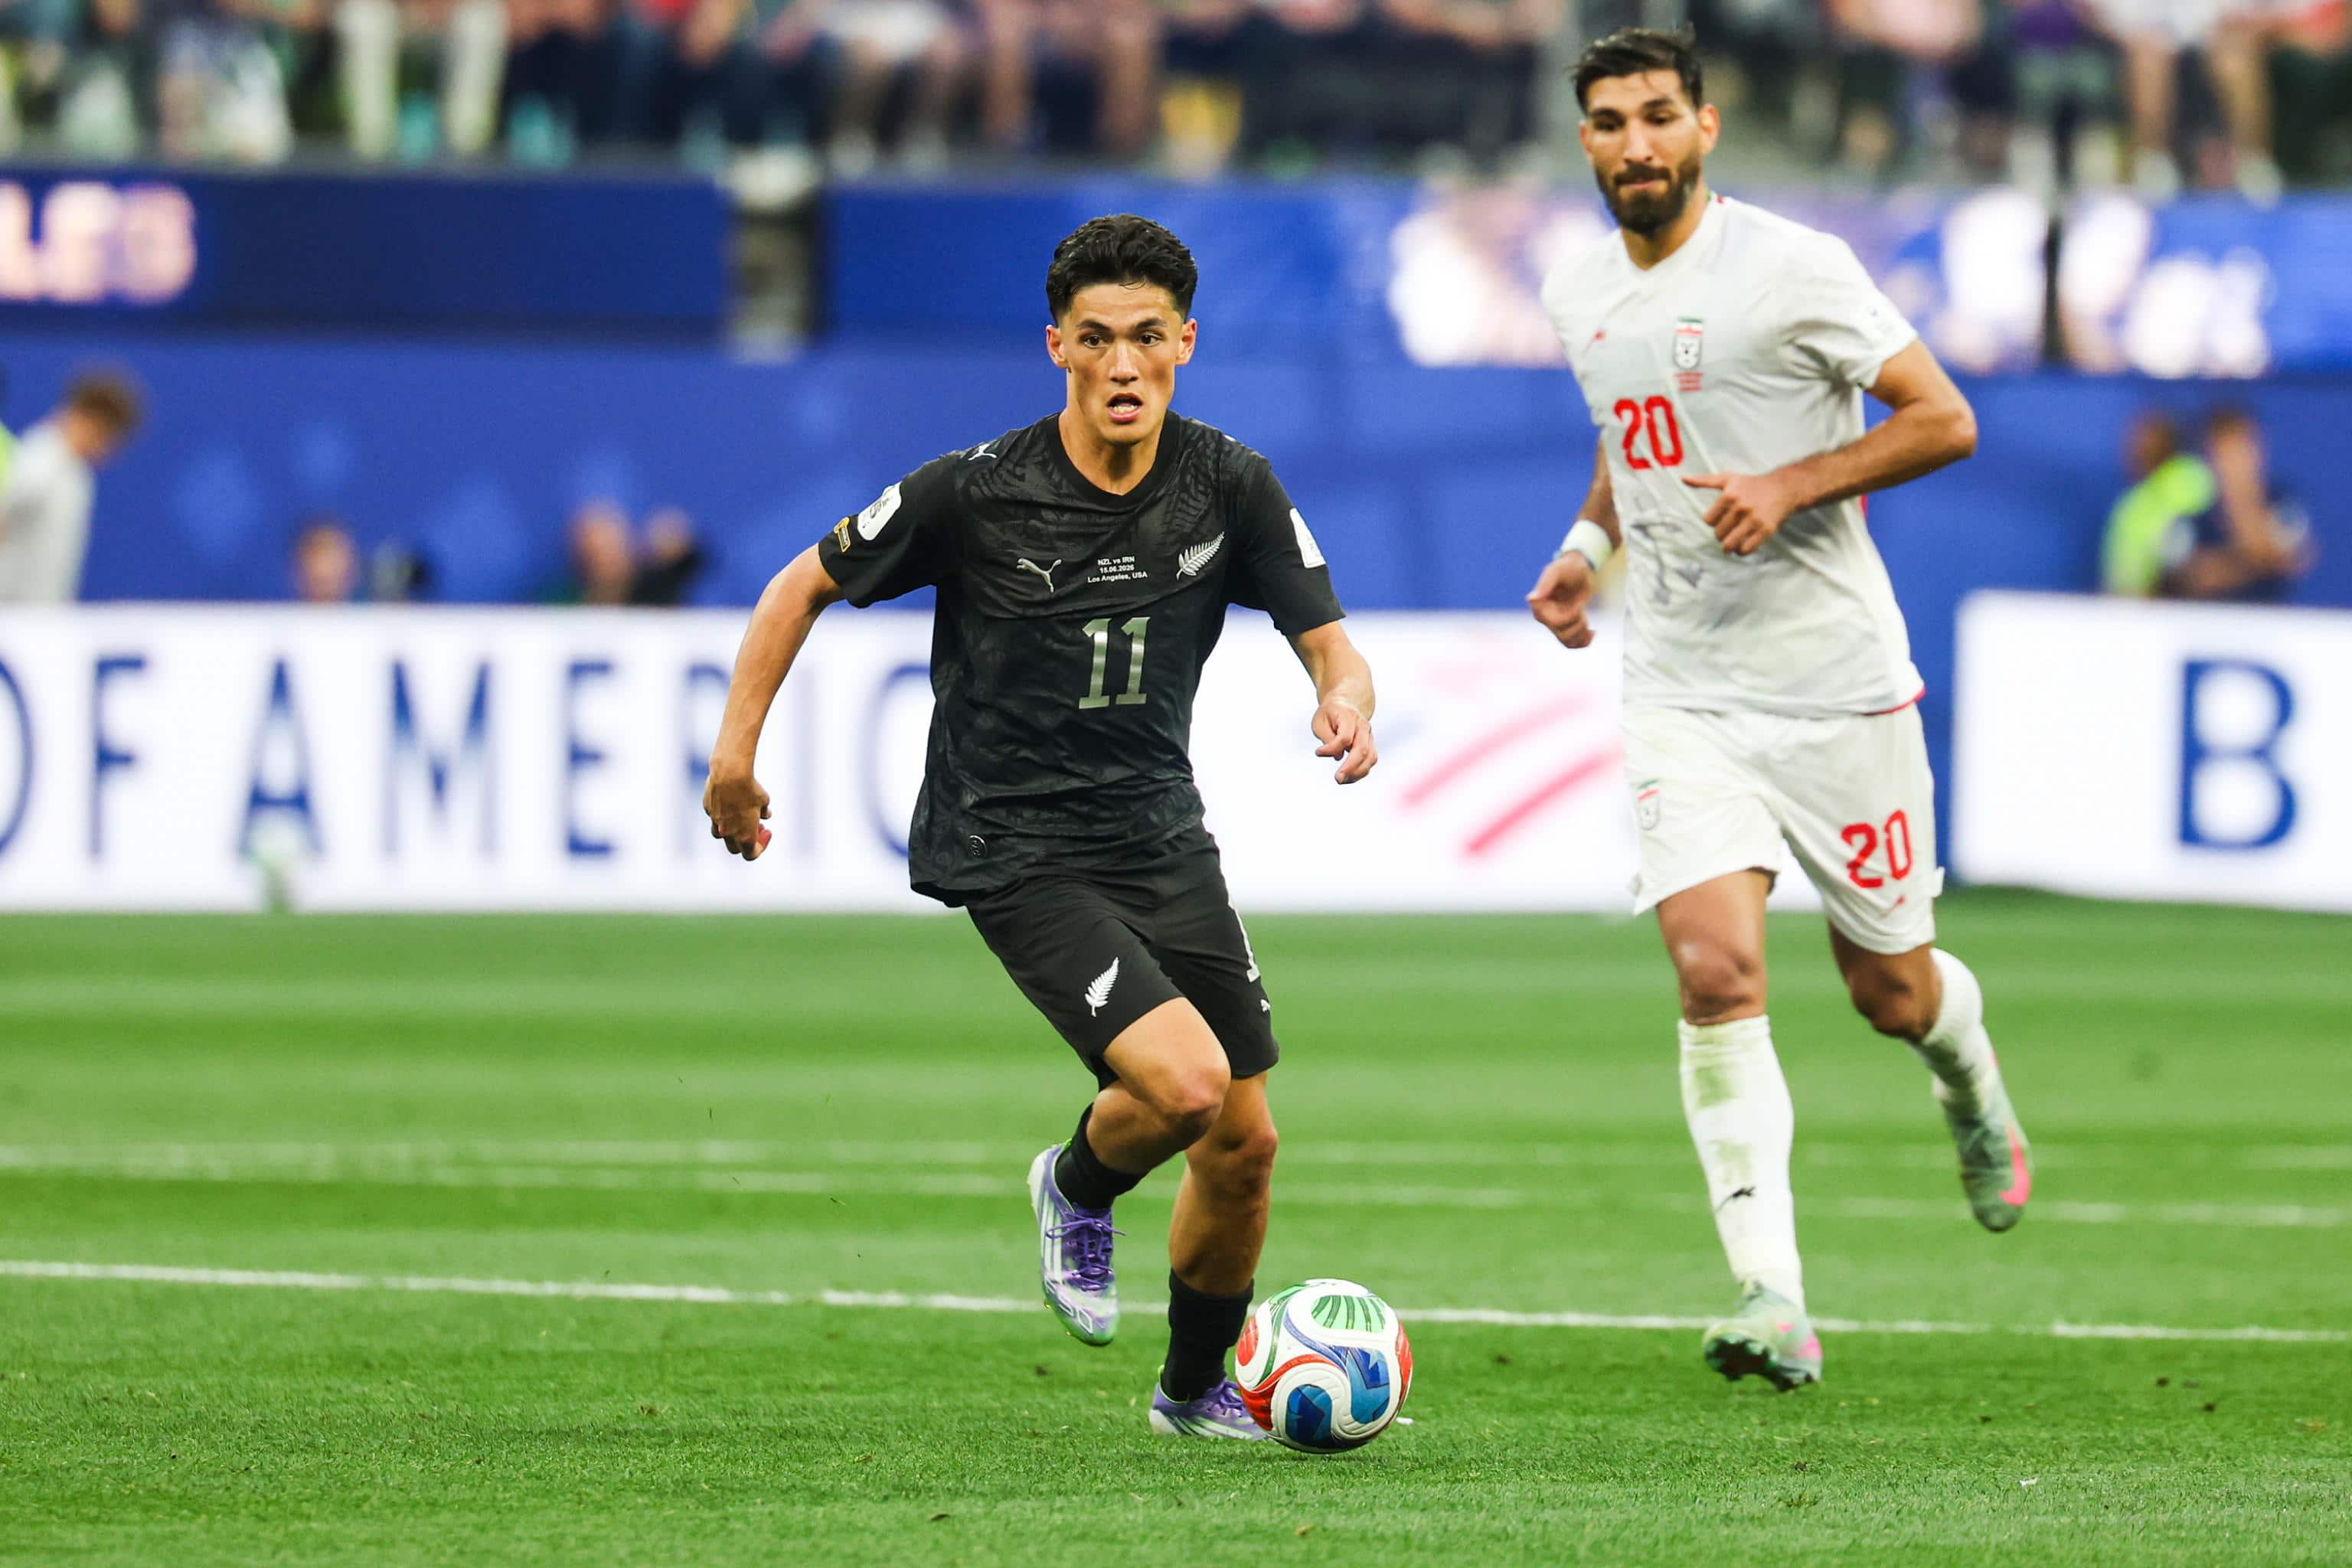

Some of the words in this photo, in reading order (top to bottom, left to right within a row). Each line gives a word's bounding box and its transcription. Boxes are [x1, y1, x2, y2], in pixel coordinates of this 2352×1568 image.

[1613, 395, 1684, 470] 20
[1078, 616, 1151, 710] 11
[0, 649, 149, 861] F
[234, 654, 936, 861] AMERIC
[1841, 809, 1913, 889] 20
